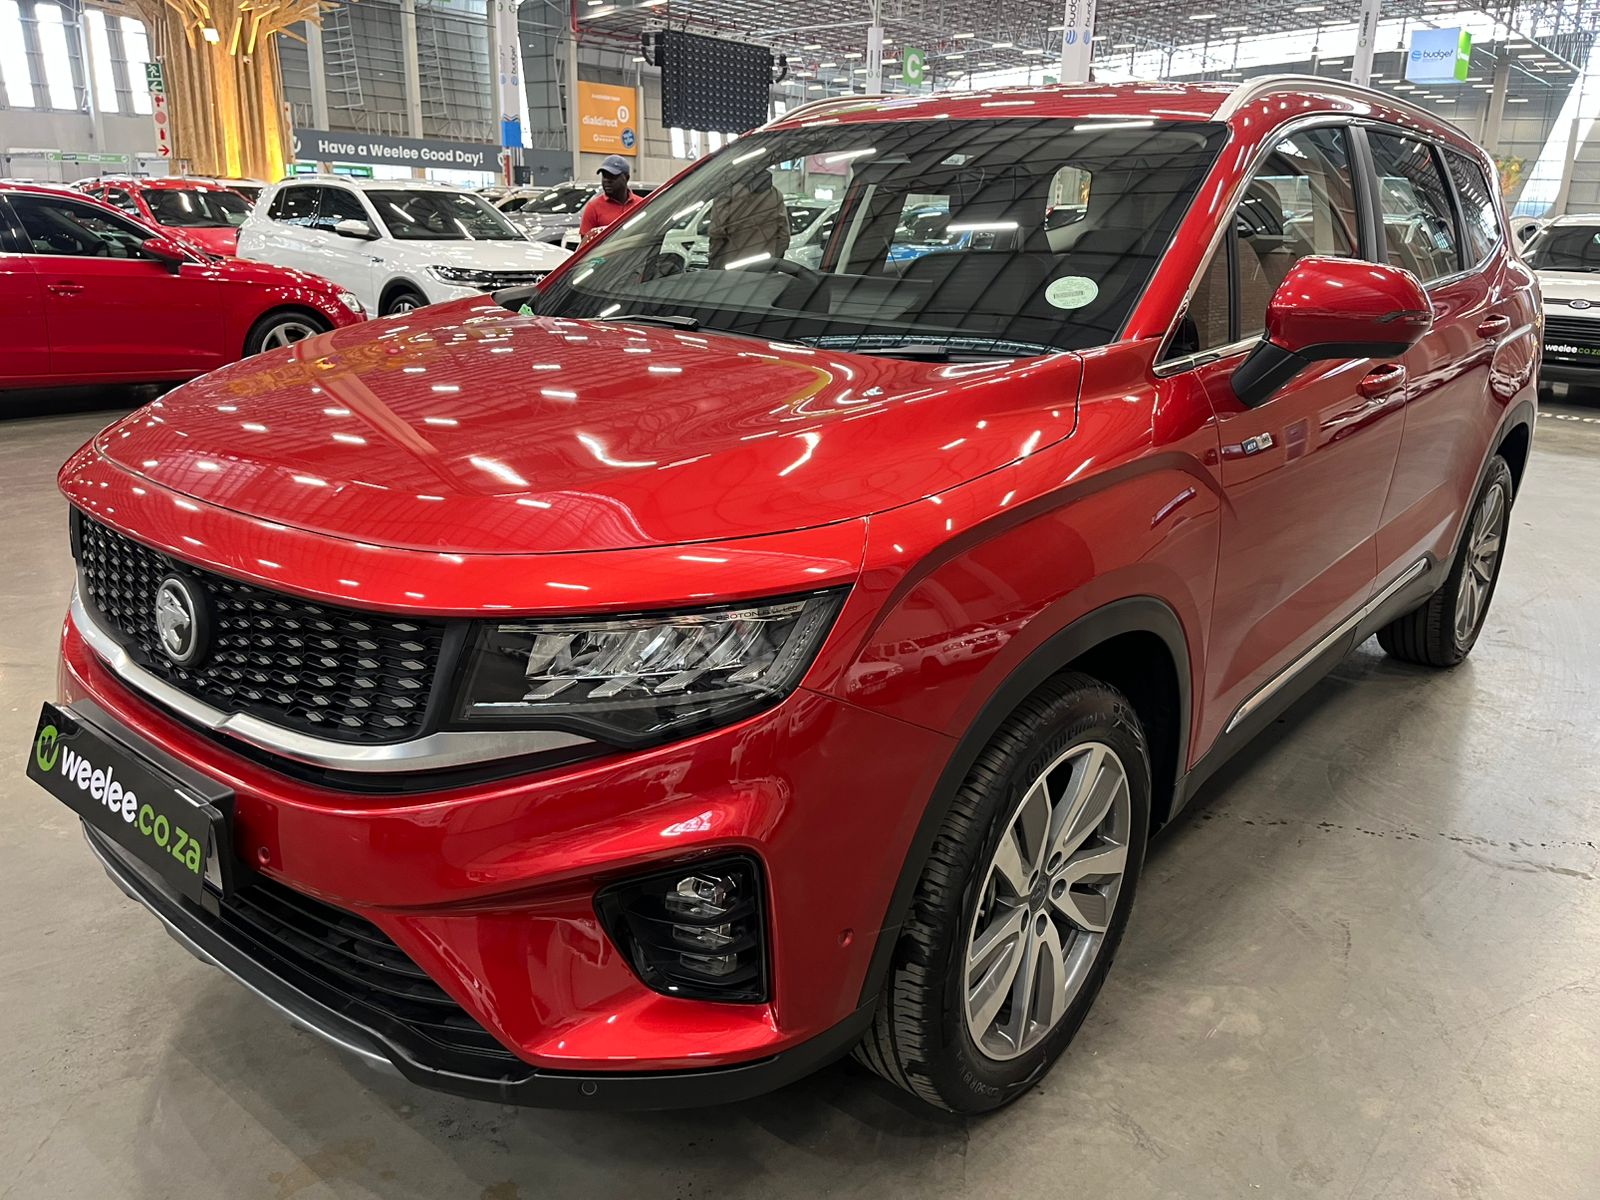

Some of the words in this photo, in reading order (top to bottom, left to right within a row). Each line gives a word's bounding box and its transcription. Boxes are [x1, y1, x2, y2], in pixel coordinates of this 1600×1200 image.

[1423, 48, 1453, 60] budget
[907, 54, 920, 79] C
[582, 115, 618, 128] dialdirect
[318, 140, 355, 155] Have
[358, 145, 367, 156] a
[369, 144, 419, 159] Weelee
[421, 148, 454, 162] Good
[456, 150, 483, 167] Day!
[716, 611, 760, 621] PROTON
[61, 745, 201, 874] weelee.co.za
